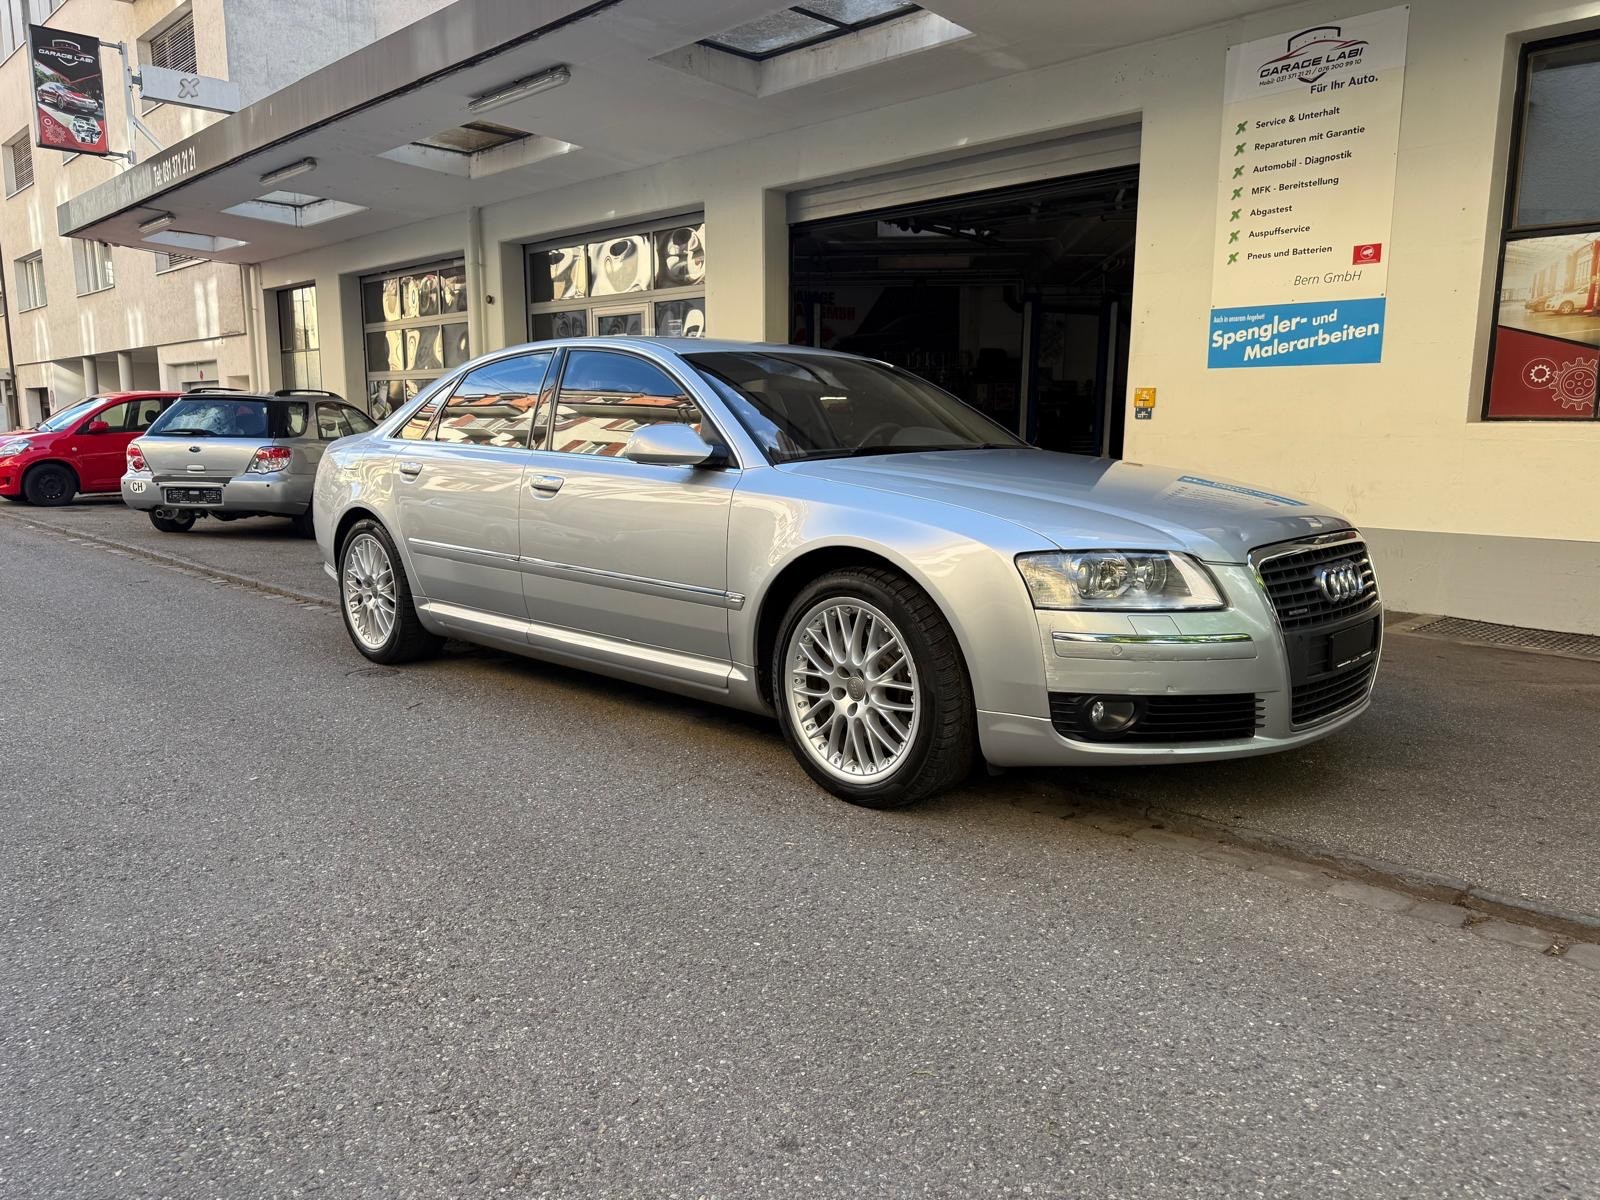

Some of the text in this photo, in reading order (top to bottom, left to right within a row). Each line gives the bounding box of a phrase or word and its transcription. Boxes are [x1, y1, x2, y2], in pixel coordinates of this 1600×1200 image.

[38, 48, 94, 64] GARAGE LABI
[1259, 47, 1364, 78] GARAGE LABI
[1331, 62, 1344, 70] 200
[1310, 74, 1379, 94] Für Ihr Auto.
[1255, 107, 1341, 129] Service & Unterhalt
[1254, 125, 1366, 152] Reparaturen mit Garantie
[1252, 158, 1297, 174] Automobil
[1304, 150, 1353, 166] Diagnostik
[1251, 185, 1271, 195] MFK
[1278, 177, 1340, 192] Bereitstellung
[1250, 204, 1293, 217] Abgastest
[1248, 225, 1311, 240] Auspuffservice
[1247, 245, 1333, 261] Pneus und Batterien
[1293, 270, 1362, 286] Bern GmbH
[1212, 308, 1338, 350] Spengler- und
[1243, 322, 1379, 361] Malerarbeiten
[132, 482, 143, 492] CH
